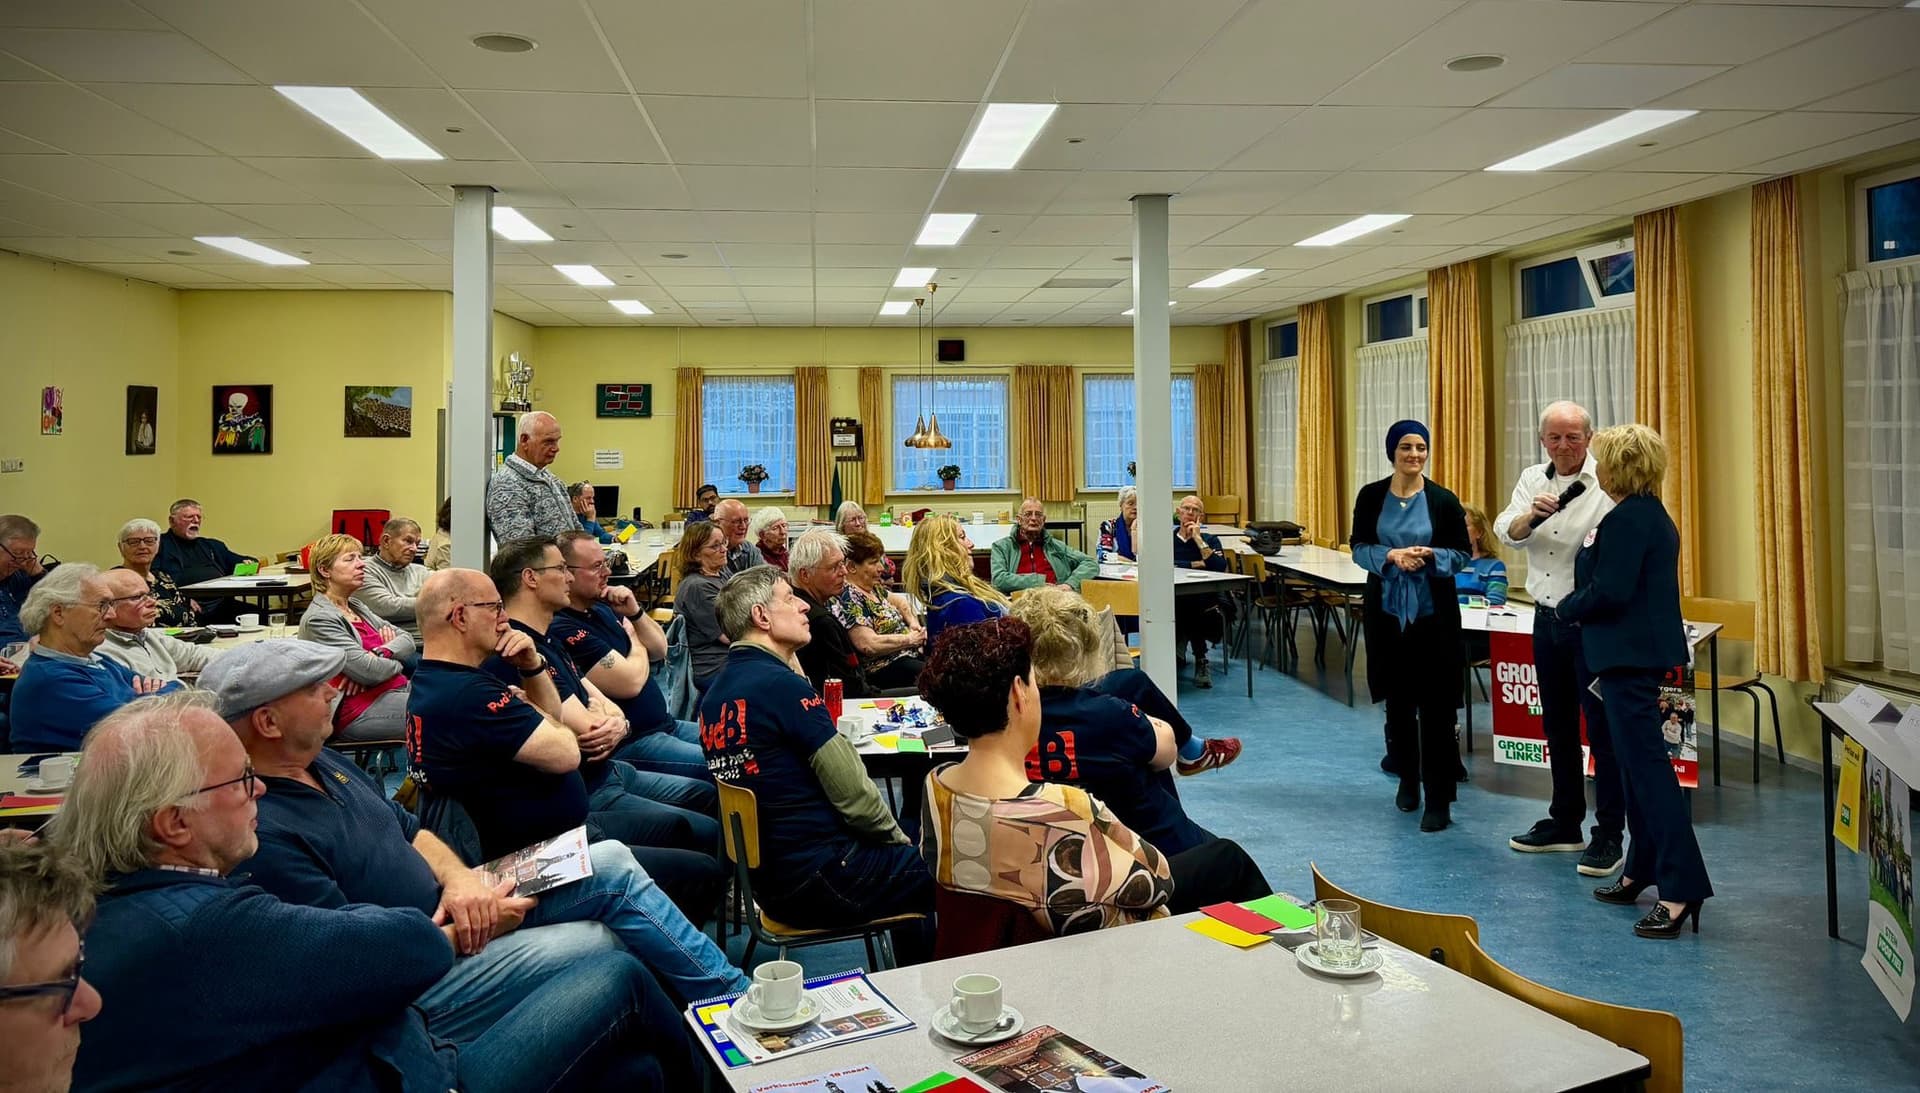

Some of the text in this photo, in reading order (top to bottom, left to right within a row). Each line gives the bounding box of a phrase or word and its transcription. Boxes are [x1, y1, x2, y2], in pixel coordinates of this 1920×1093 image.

[1658, 685, 1683, 693] rgers
[1498, 740, 1542, 753] GROEN
[1505, 749, 1542, 763] LINKS
[1542, 744, 1550, 763] P
